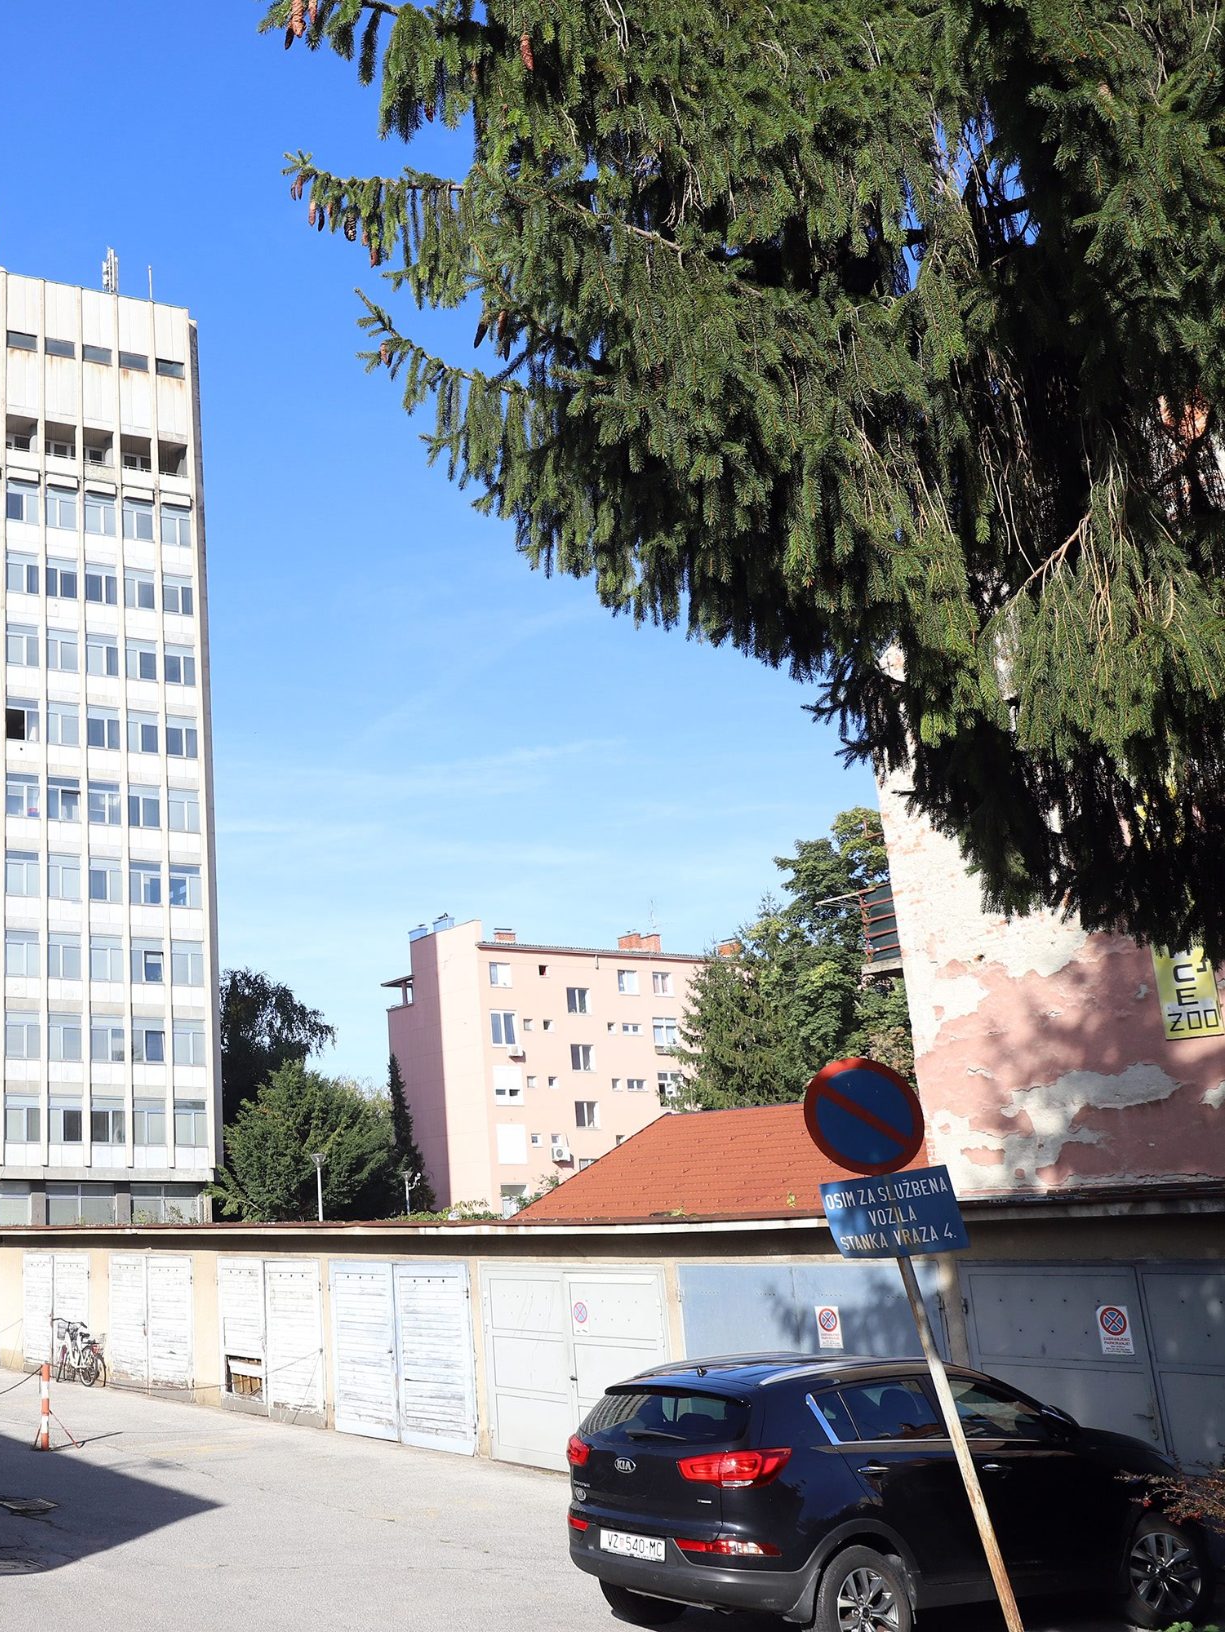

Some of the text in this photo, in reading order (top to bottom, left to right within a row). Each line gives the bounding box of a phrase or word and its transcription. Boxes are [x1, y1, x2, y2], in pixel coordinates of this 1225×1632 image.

[825, 1177, 949, 1210] OSIM ZA SLUŽBENA
[868, 1205, 917, 1226] VOZILA
[840, 1222, 957, 1251] STANKA VRAZA 4.
[616, 1459, 632, 1471] KIA
[607, 1533, 619, 1549] VZ
